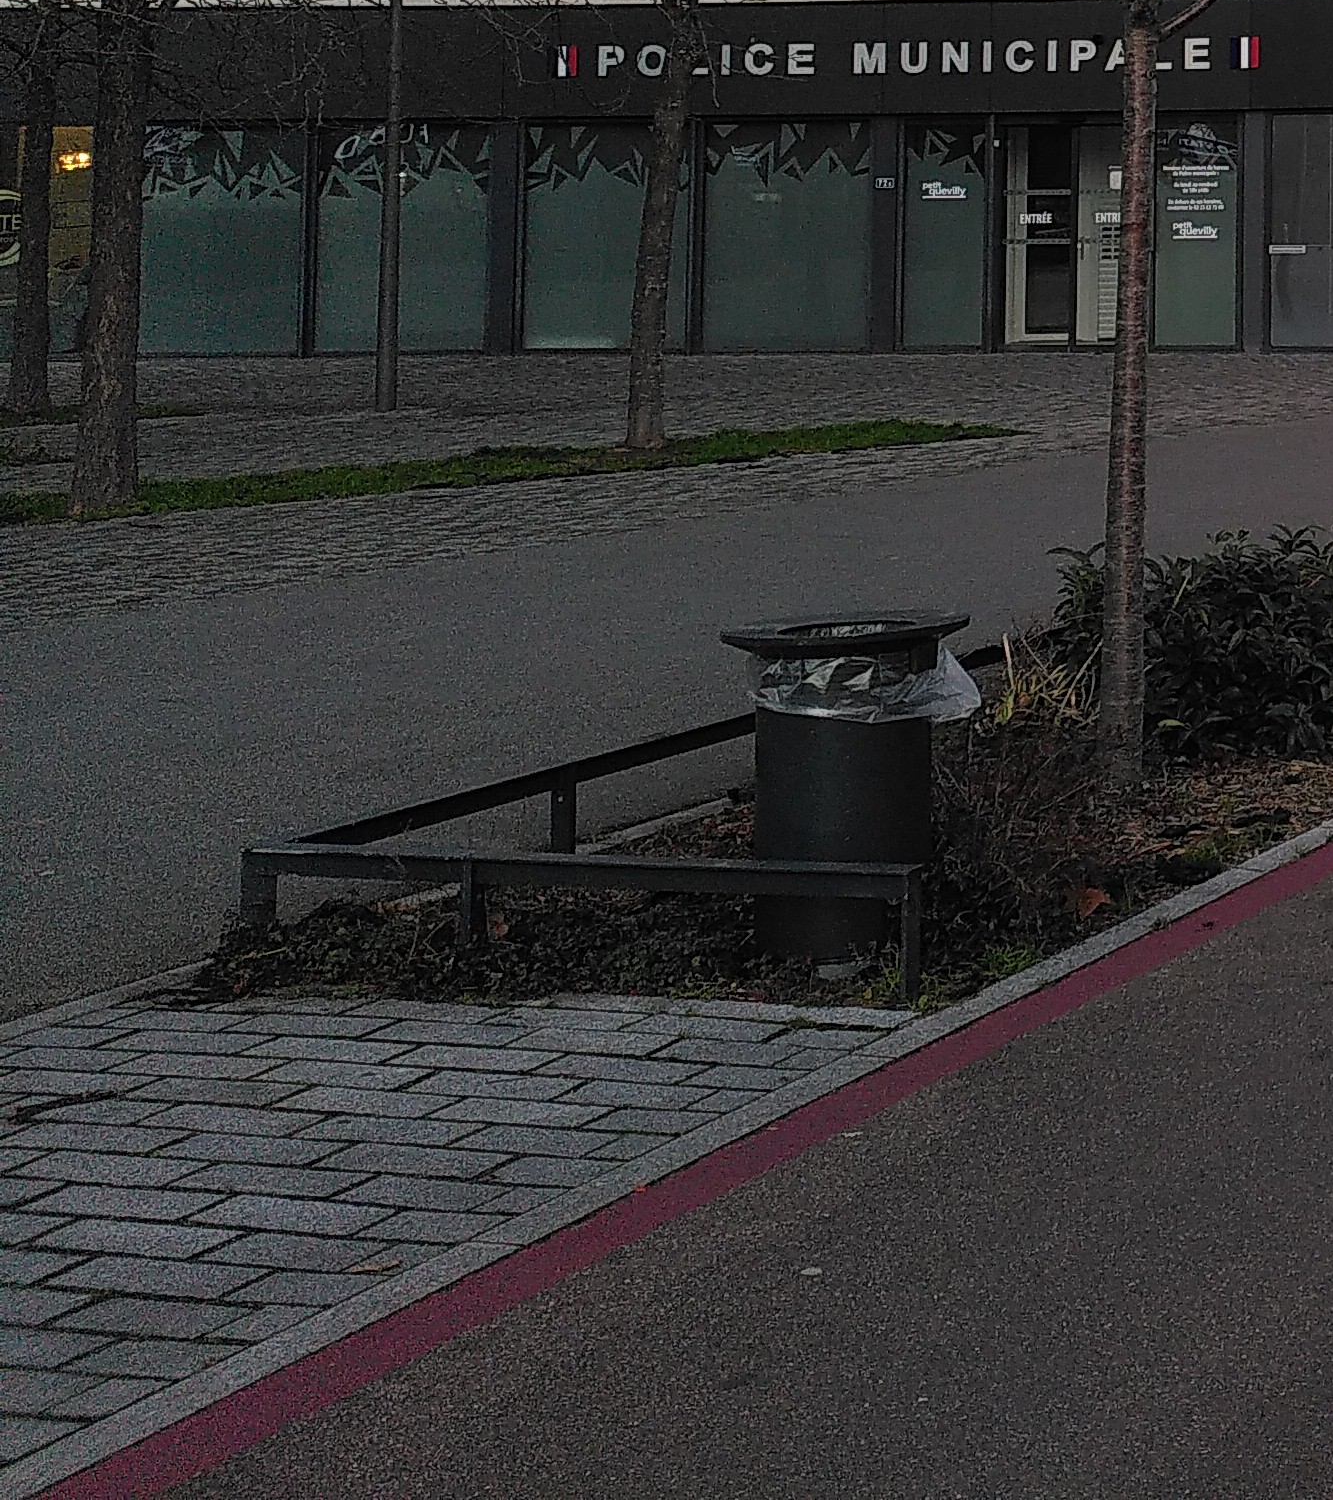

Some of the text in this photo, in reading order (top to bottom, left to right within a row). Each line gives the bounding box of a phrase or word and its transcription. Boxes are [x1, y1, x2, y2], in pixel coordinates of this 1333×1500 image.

[597, 37, 1211, 77] POICE MUNICIPAE
[922, 182, 942, 190] petit
[929, 186, 967, 197] quevilly
[1019, 211, 1053, 224] ENTRÉE
[1095, 211, 1121, 224] ENTR
[1173, 222, 1192, 230] petit
[1180, 226, 1218, 236] quevilly
